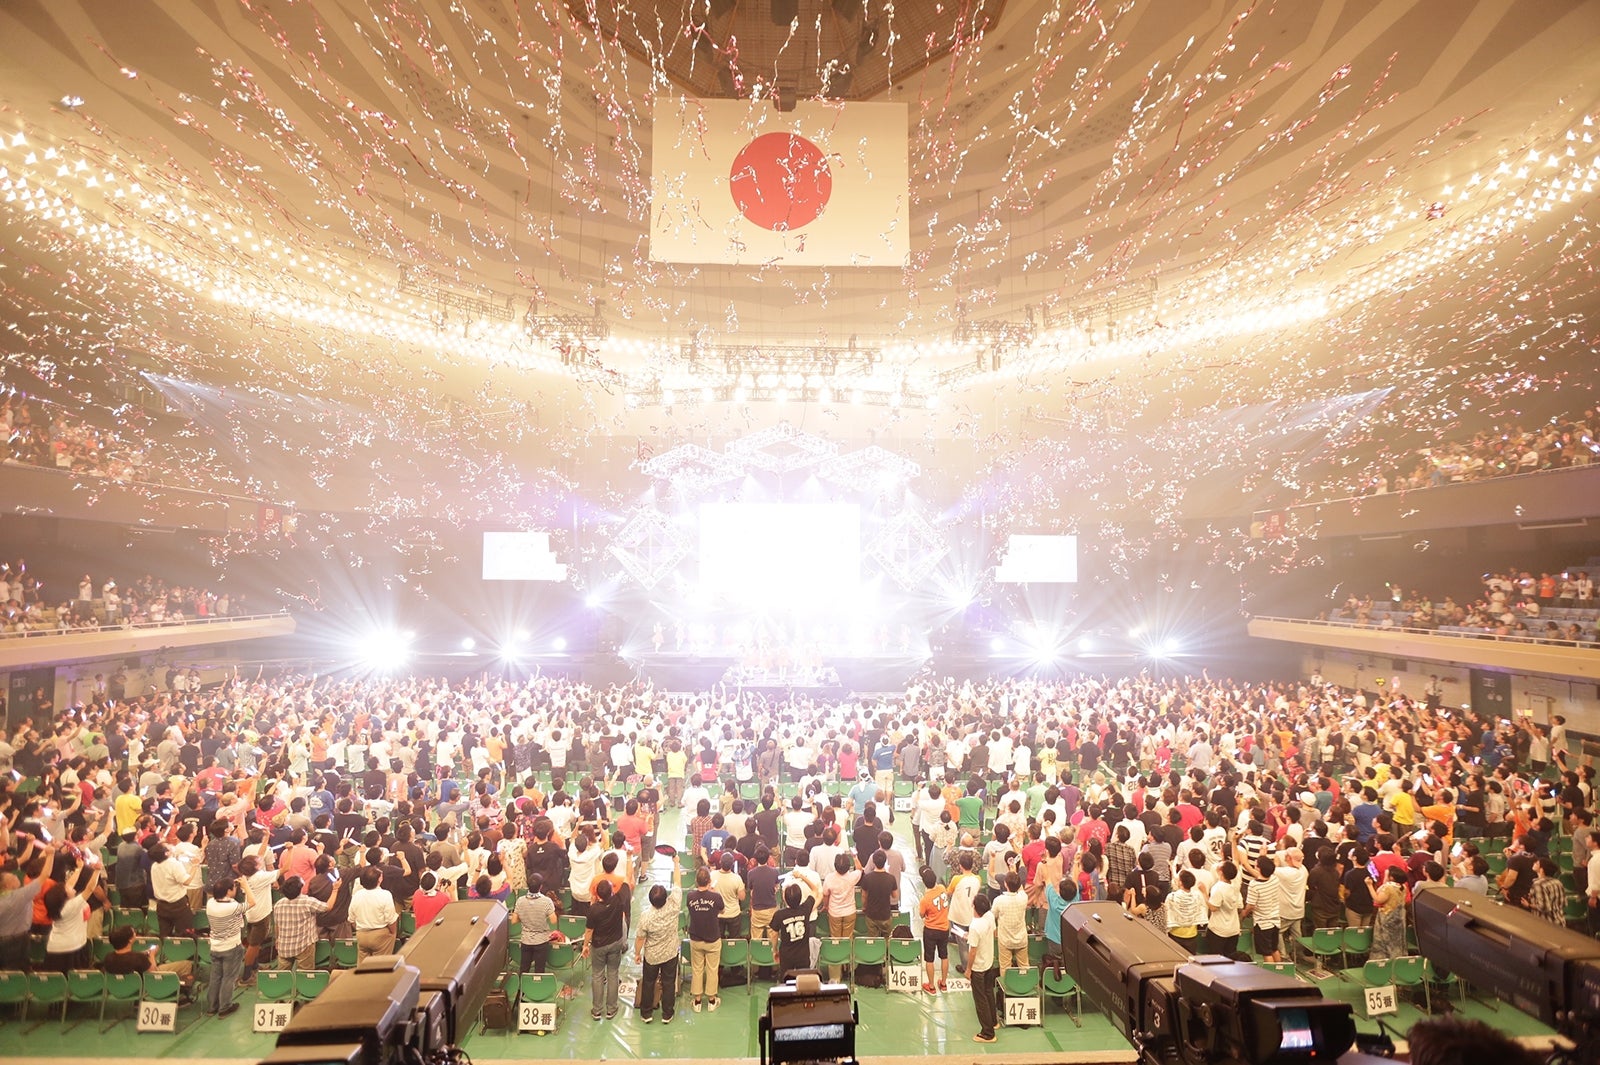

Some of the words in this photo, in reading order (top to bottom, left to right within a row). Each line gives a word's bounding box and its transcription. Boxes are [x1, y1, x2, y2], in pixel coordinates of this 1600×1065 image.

[891, 971, 919, 987] 46番
[1368, 992, 1392, 1010] 55番
[142, 1007, 172, 1026] 30番
[257, 1008, 287, 1027] 31番
[522, 1008, 552, 1026] 38番
[1009, 1002, 1037, 1020] 47番
